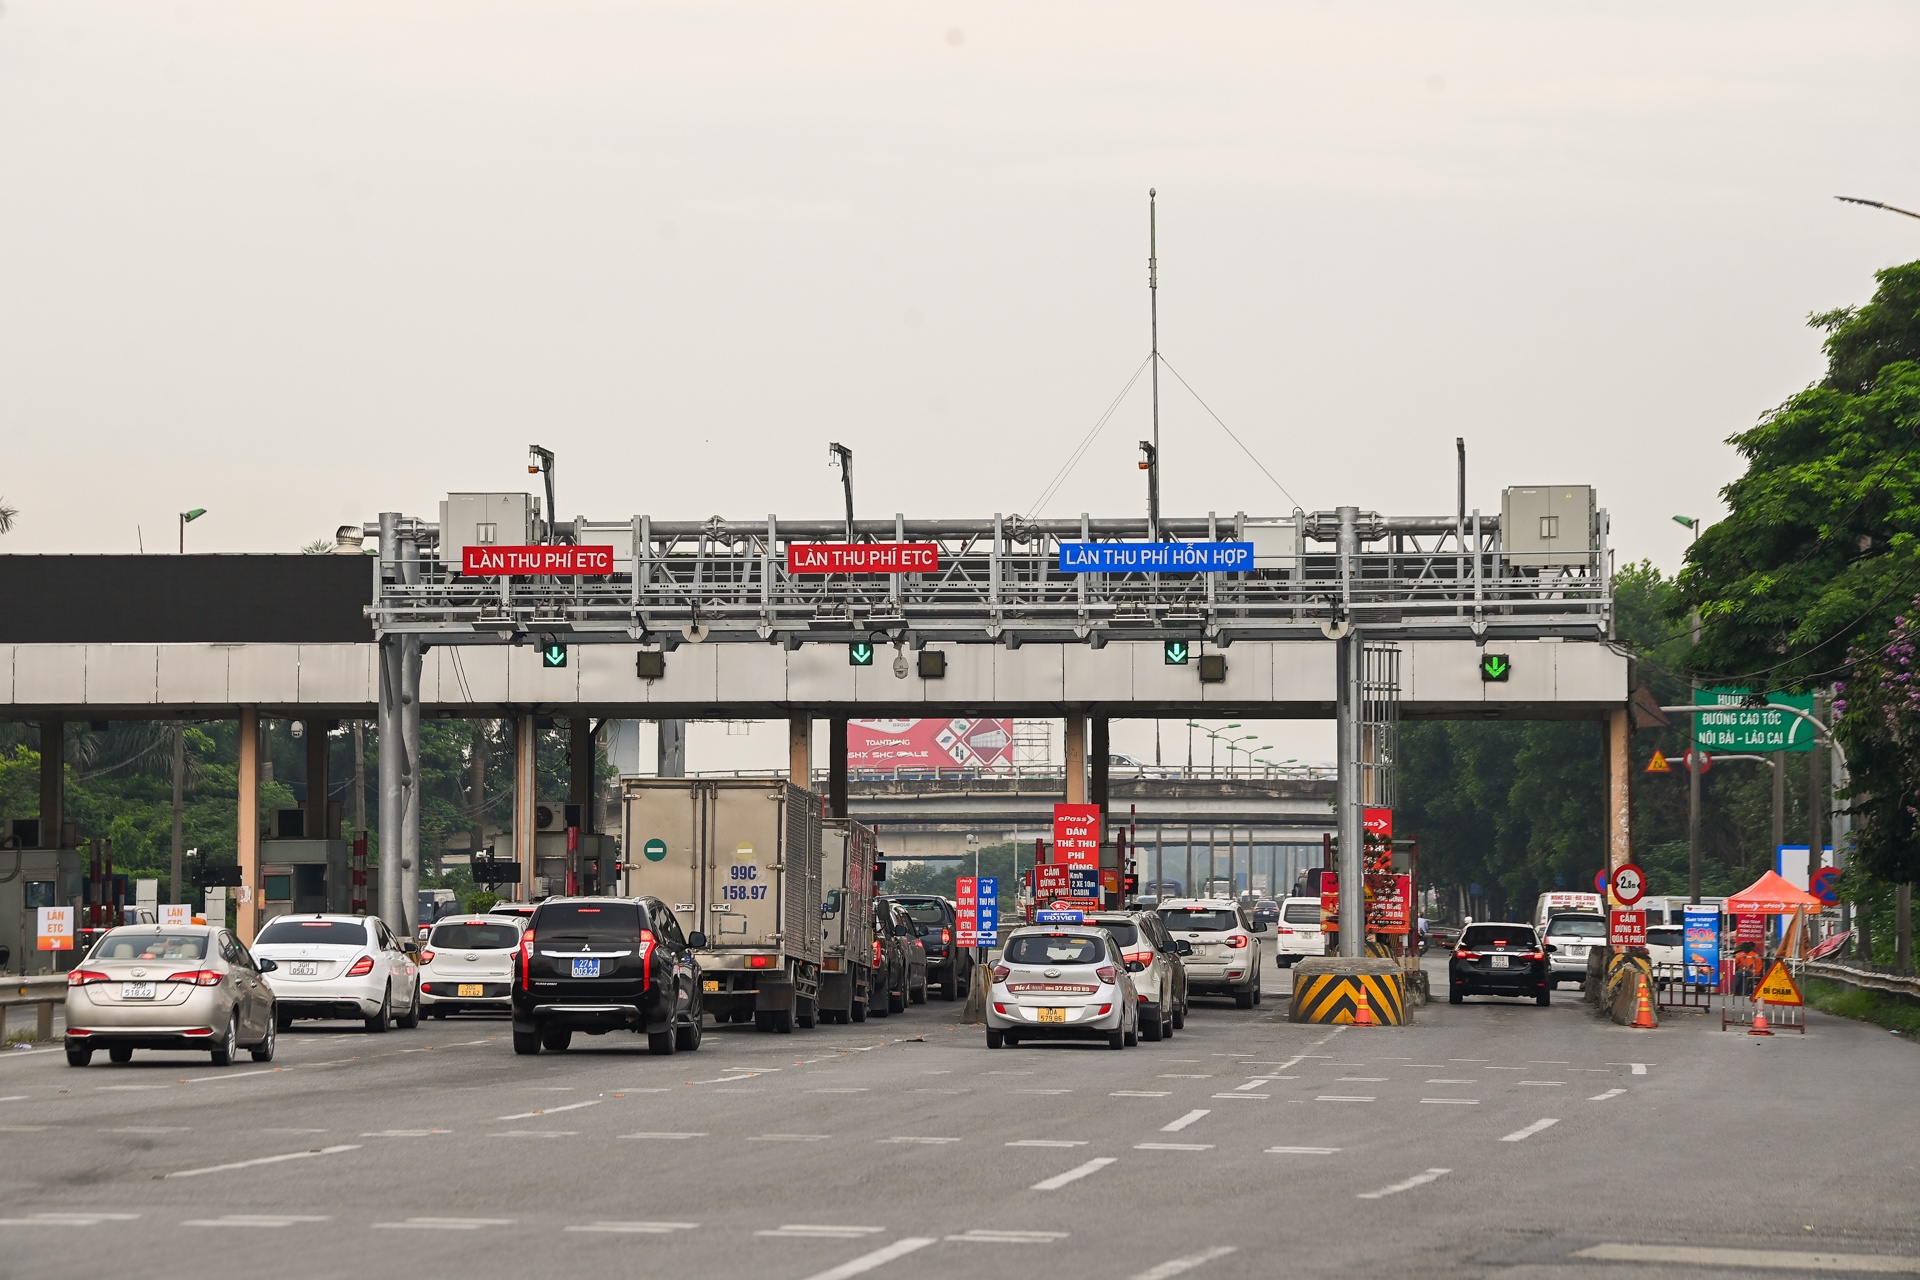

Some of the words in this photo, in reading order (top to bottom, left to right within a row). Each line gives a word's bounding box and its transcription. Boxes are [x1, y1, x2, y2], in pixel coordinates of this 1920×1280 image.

[469, 549, 504, 568] LÀN
[507, 553, 540, 568] THU
[545, 549, 573, 568] PHÍ
[577, 552, 607, 568] ETC
[795, 548, 828, 566] LÀN
[832, 551, 865, 565] THU
[870, 547, 897, 565] PHÍ
[901, 550, 932, 565] ETC
[1066, 546, 1099, 565] LÀN
[1103, 550, 1136, 565] THU
[1141, 546, 1169, 565] PHÍ
[1173, 542, 1206, 565] HỖN
[1213, 548, 1247, 566] HỢP
[1740, 712, 1759, 725] CAO
[1762, 709, 1782, 725] TỐC
[1699, 729, 1716, 745] NỘI
[1767, 732, 1783, 744] CAI
[1066, 827, 1087, 836] DÁN
[1056, 838, 1075, 848] THẺ
[1077, 840, 1096, 848] THU
[1067, 851, 1085, 859] PHÍ
[730, 865, 757, 880] 99C
[1044, 866, 1059, 877] CẤM
[1058, 878, 1066, 886] XE
[721, 885, 767, 900] 158.97
[962, 885, 970, 894] LÀN
[983, 885, 992, 894] LÀN
[1055, 886, 1069, 896] PHÚT
[1073, 888, 1089, 896] CABIN
[967, 896, 975, 905] PHÍ
[47, 910, 65, 921] LÀN
[167, 908, 183, 917] LÀN
[1620, 912, 1636, 923] CẤM
[47, 923, 64, 933] ETC
[1633, 925, 1641, 933] XE
[1629, 934, 1645, 943] PHÚT
[1686, 927, 1717, 942] 50k
[580, 959, 593, 968] 27A
[574, 967, 598, 976] 003.22
[124, 989, 152, 997] 518.42
